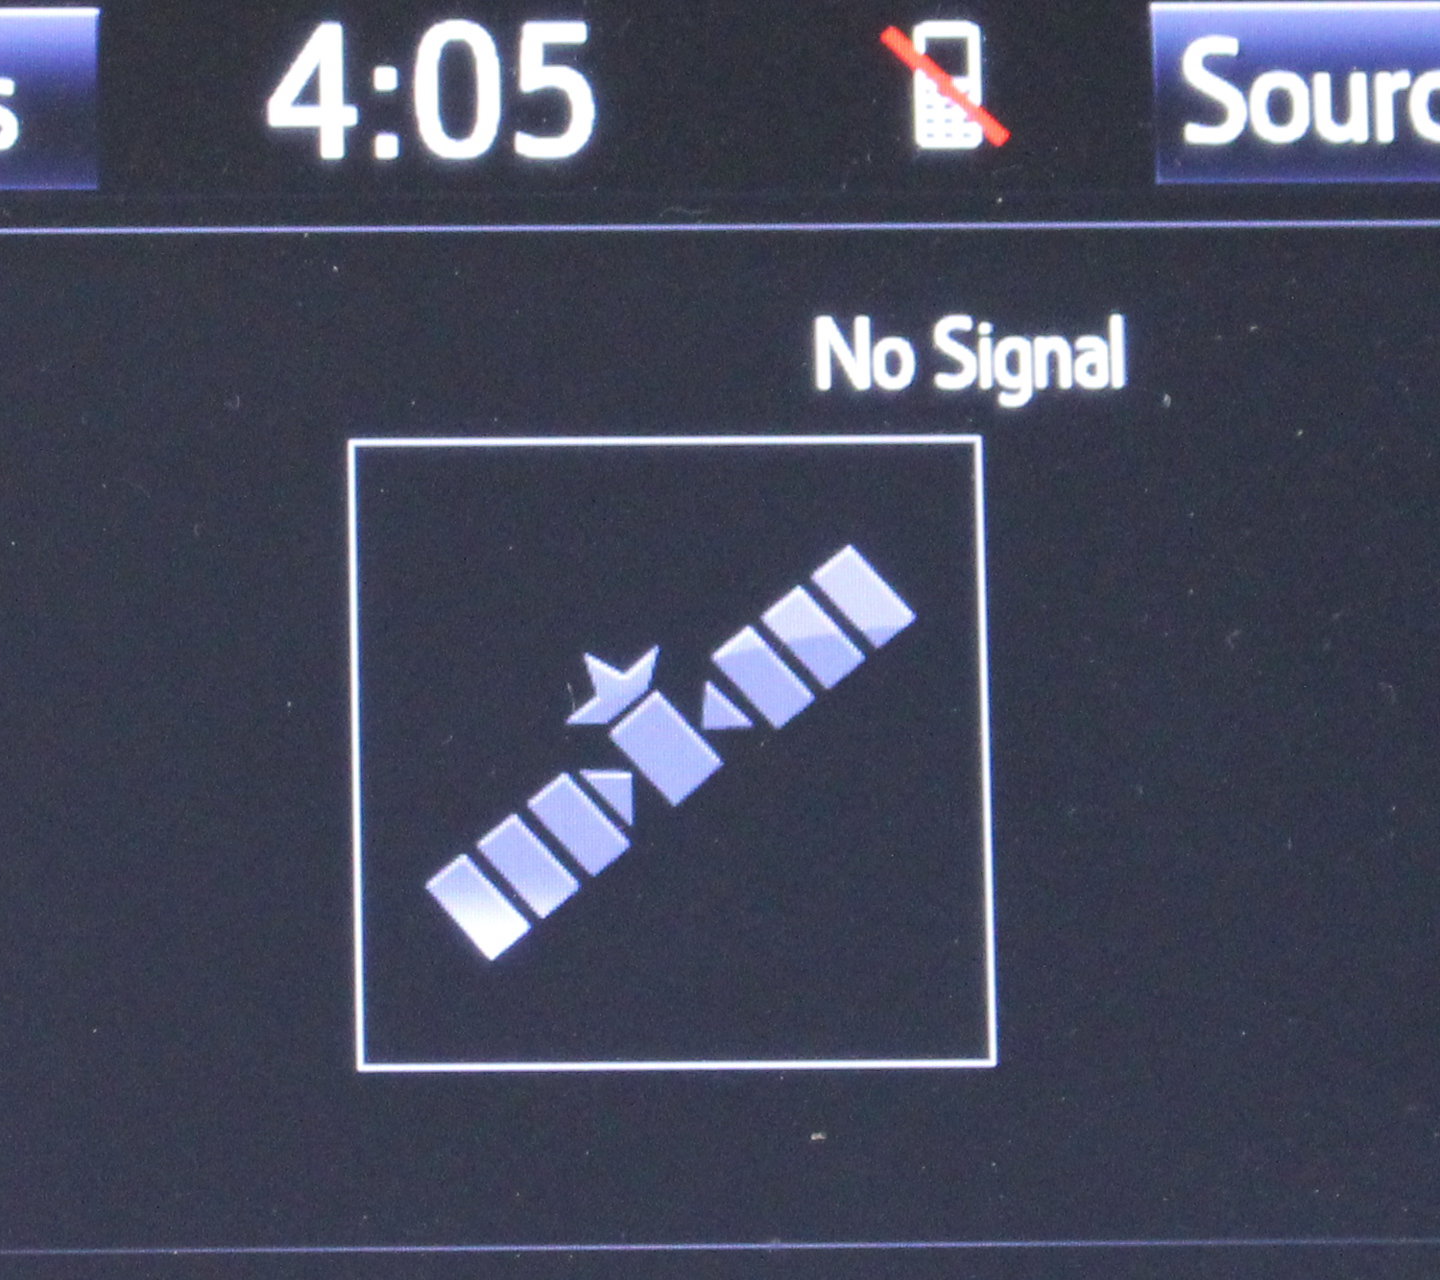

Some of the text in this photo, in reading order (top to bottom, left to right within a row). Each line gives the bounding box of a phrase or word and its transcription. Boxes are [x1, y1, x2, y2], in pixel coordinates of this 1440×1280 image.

[265, 19, 597, 162] 4:05
[813, 314, 1127, 410] No Signal
